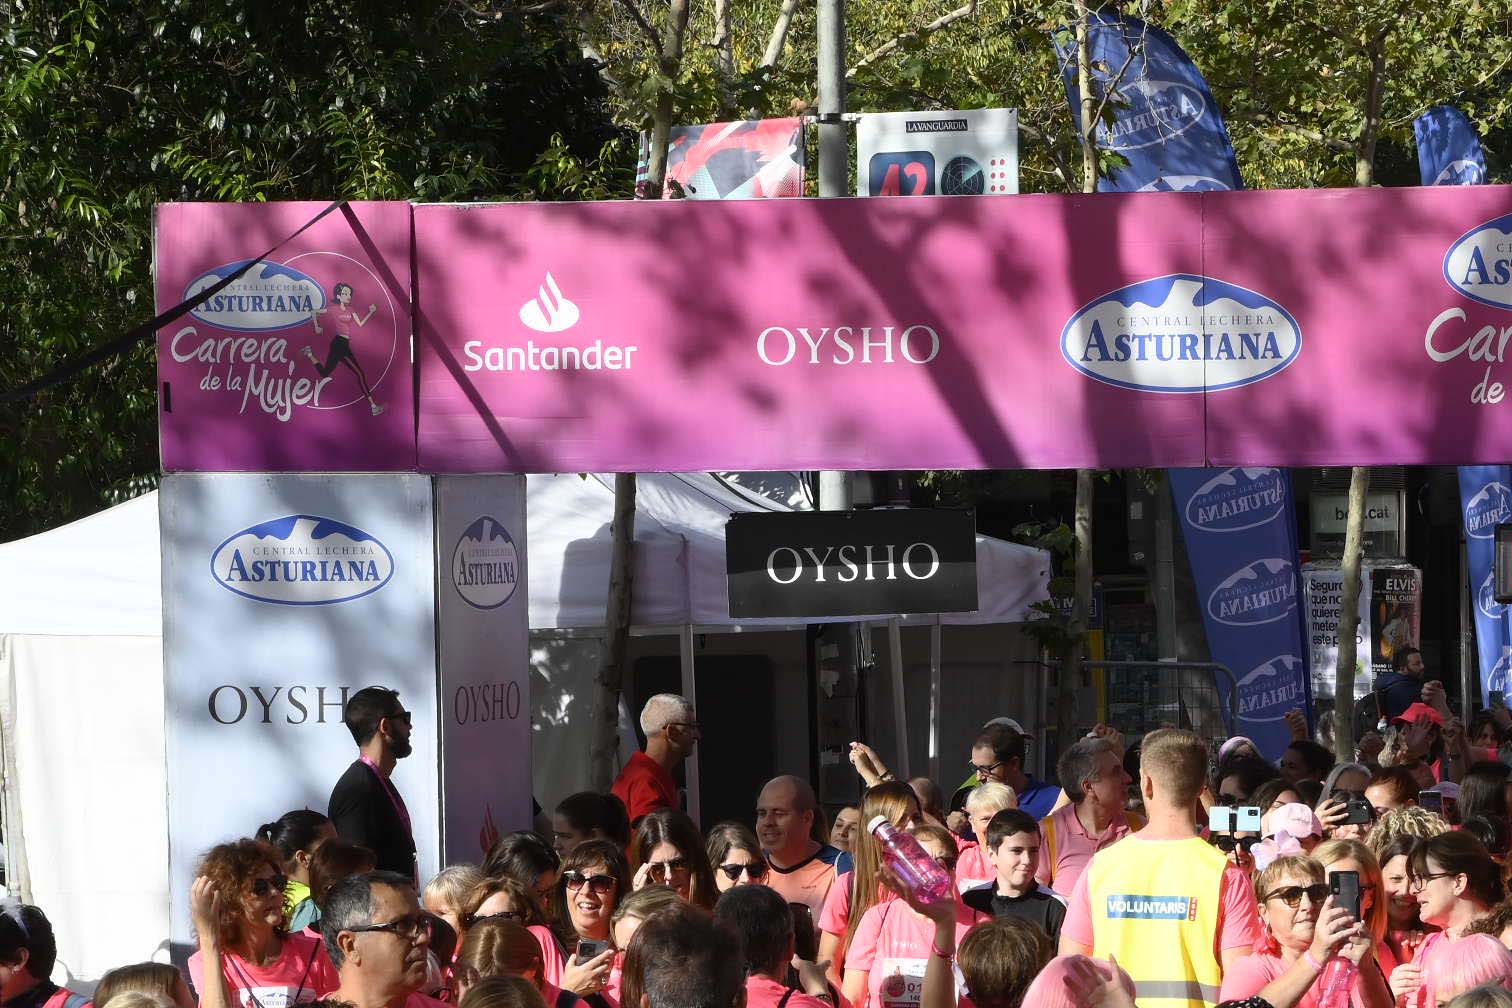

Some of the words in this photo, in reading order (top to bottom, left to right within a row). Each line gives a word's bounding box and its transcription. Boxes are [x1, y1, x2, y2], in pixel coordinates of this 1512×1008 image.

[1117, 316, 1191, 328] CENTRAL
[1199, 314, 1275, 326] LECHERA
[171, 326, 288, 363] Carrera
[463, 340, 638, 372] Santander
[755, 325, 940, 366] OYSHO
[1080, 318, 1283, 362] ASTURIANA
[200, 365, 221, 391] de
[227, 364, 241, 391] la
[239, 360, 333, 422] Mujer
[1470, 366, 1505, 405] de
[224, 548, 382, 582] ASTURIANA
[252, 546, 311, 556] CENTRAL
[316, 545, 375, 555] LECHERA
[766, 543, 941, 584] OYSHO
[457, 551, 516, 587] ASTURIANA
[1385, 578, 1416, 591] ELVIS
[1311, 594, 1328, 605] que
[1313, 634, 1331, 645] este
[208, 684, 391, 725] OYSH
[454, 680, 521, 725] OYSHO
[1108, 901, 1186, 914] VOLUNTARIS
